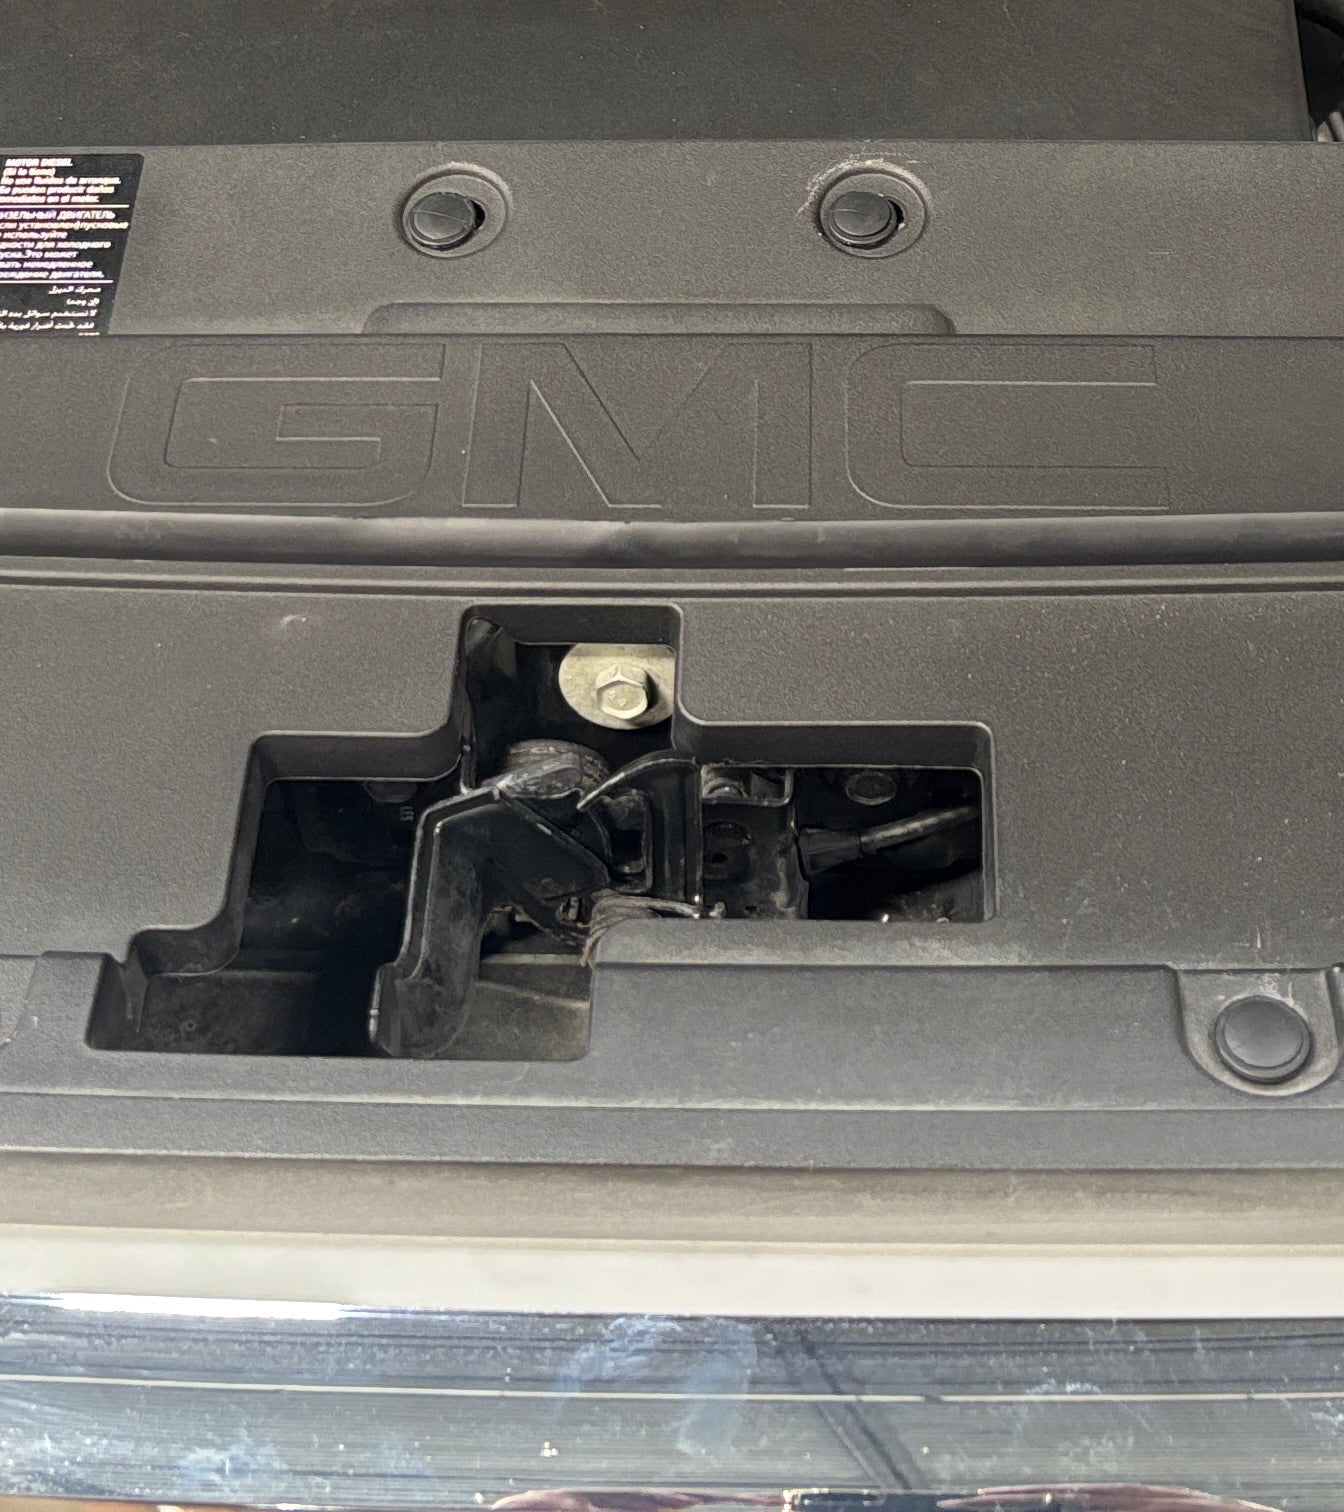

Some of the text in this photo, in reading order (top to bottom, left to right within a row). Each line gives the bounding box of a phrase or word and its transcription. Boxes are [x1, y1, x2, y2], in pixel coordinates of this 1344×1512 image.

[5, 158, 73, 167] MOTOR DIESEL
[57, 211, 116, 221] ДВИГАТЕЛЬ
[107, 342, 1169, 510] GMC
